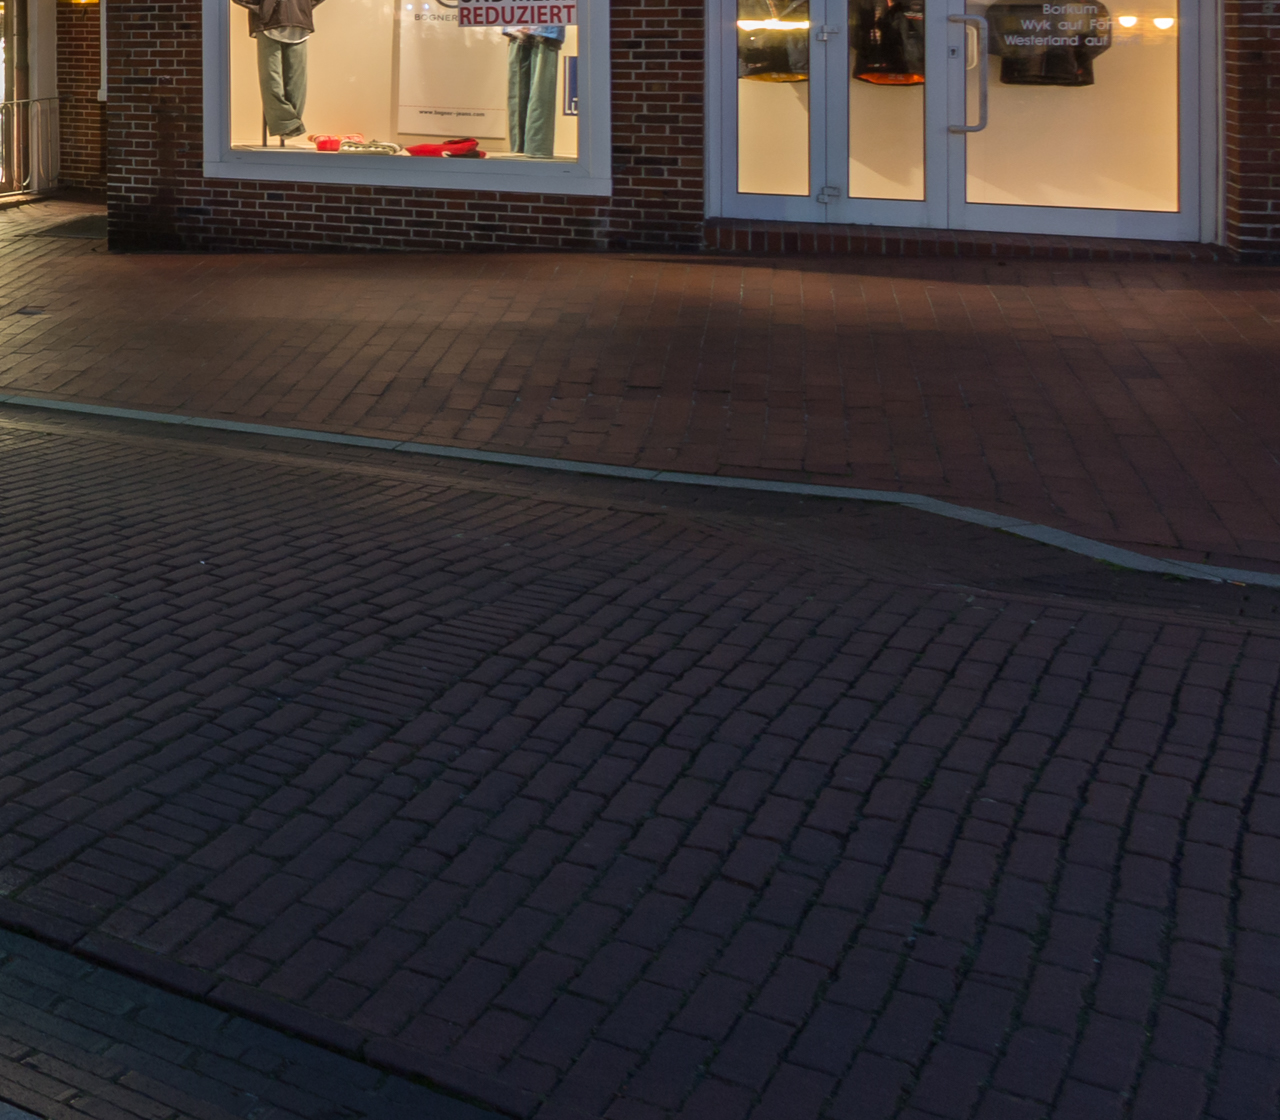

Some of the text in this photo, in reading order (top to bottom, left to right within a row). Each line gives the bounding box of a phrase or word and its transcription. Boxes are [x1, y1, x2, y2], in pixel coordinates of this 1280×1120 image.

[459, 4, 576, 25] REDUZIERT
[1042, 4, 1098, 15] Borkum
[414, 13, 459, 22] BOGNER
[1020, 19, 1052, 31] Wyk
[1058, 19, 1083, 31] auf
[1004, 34, 1079, 46] Westerland
[1084, 34, 1109, 46] auf
